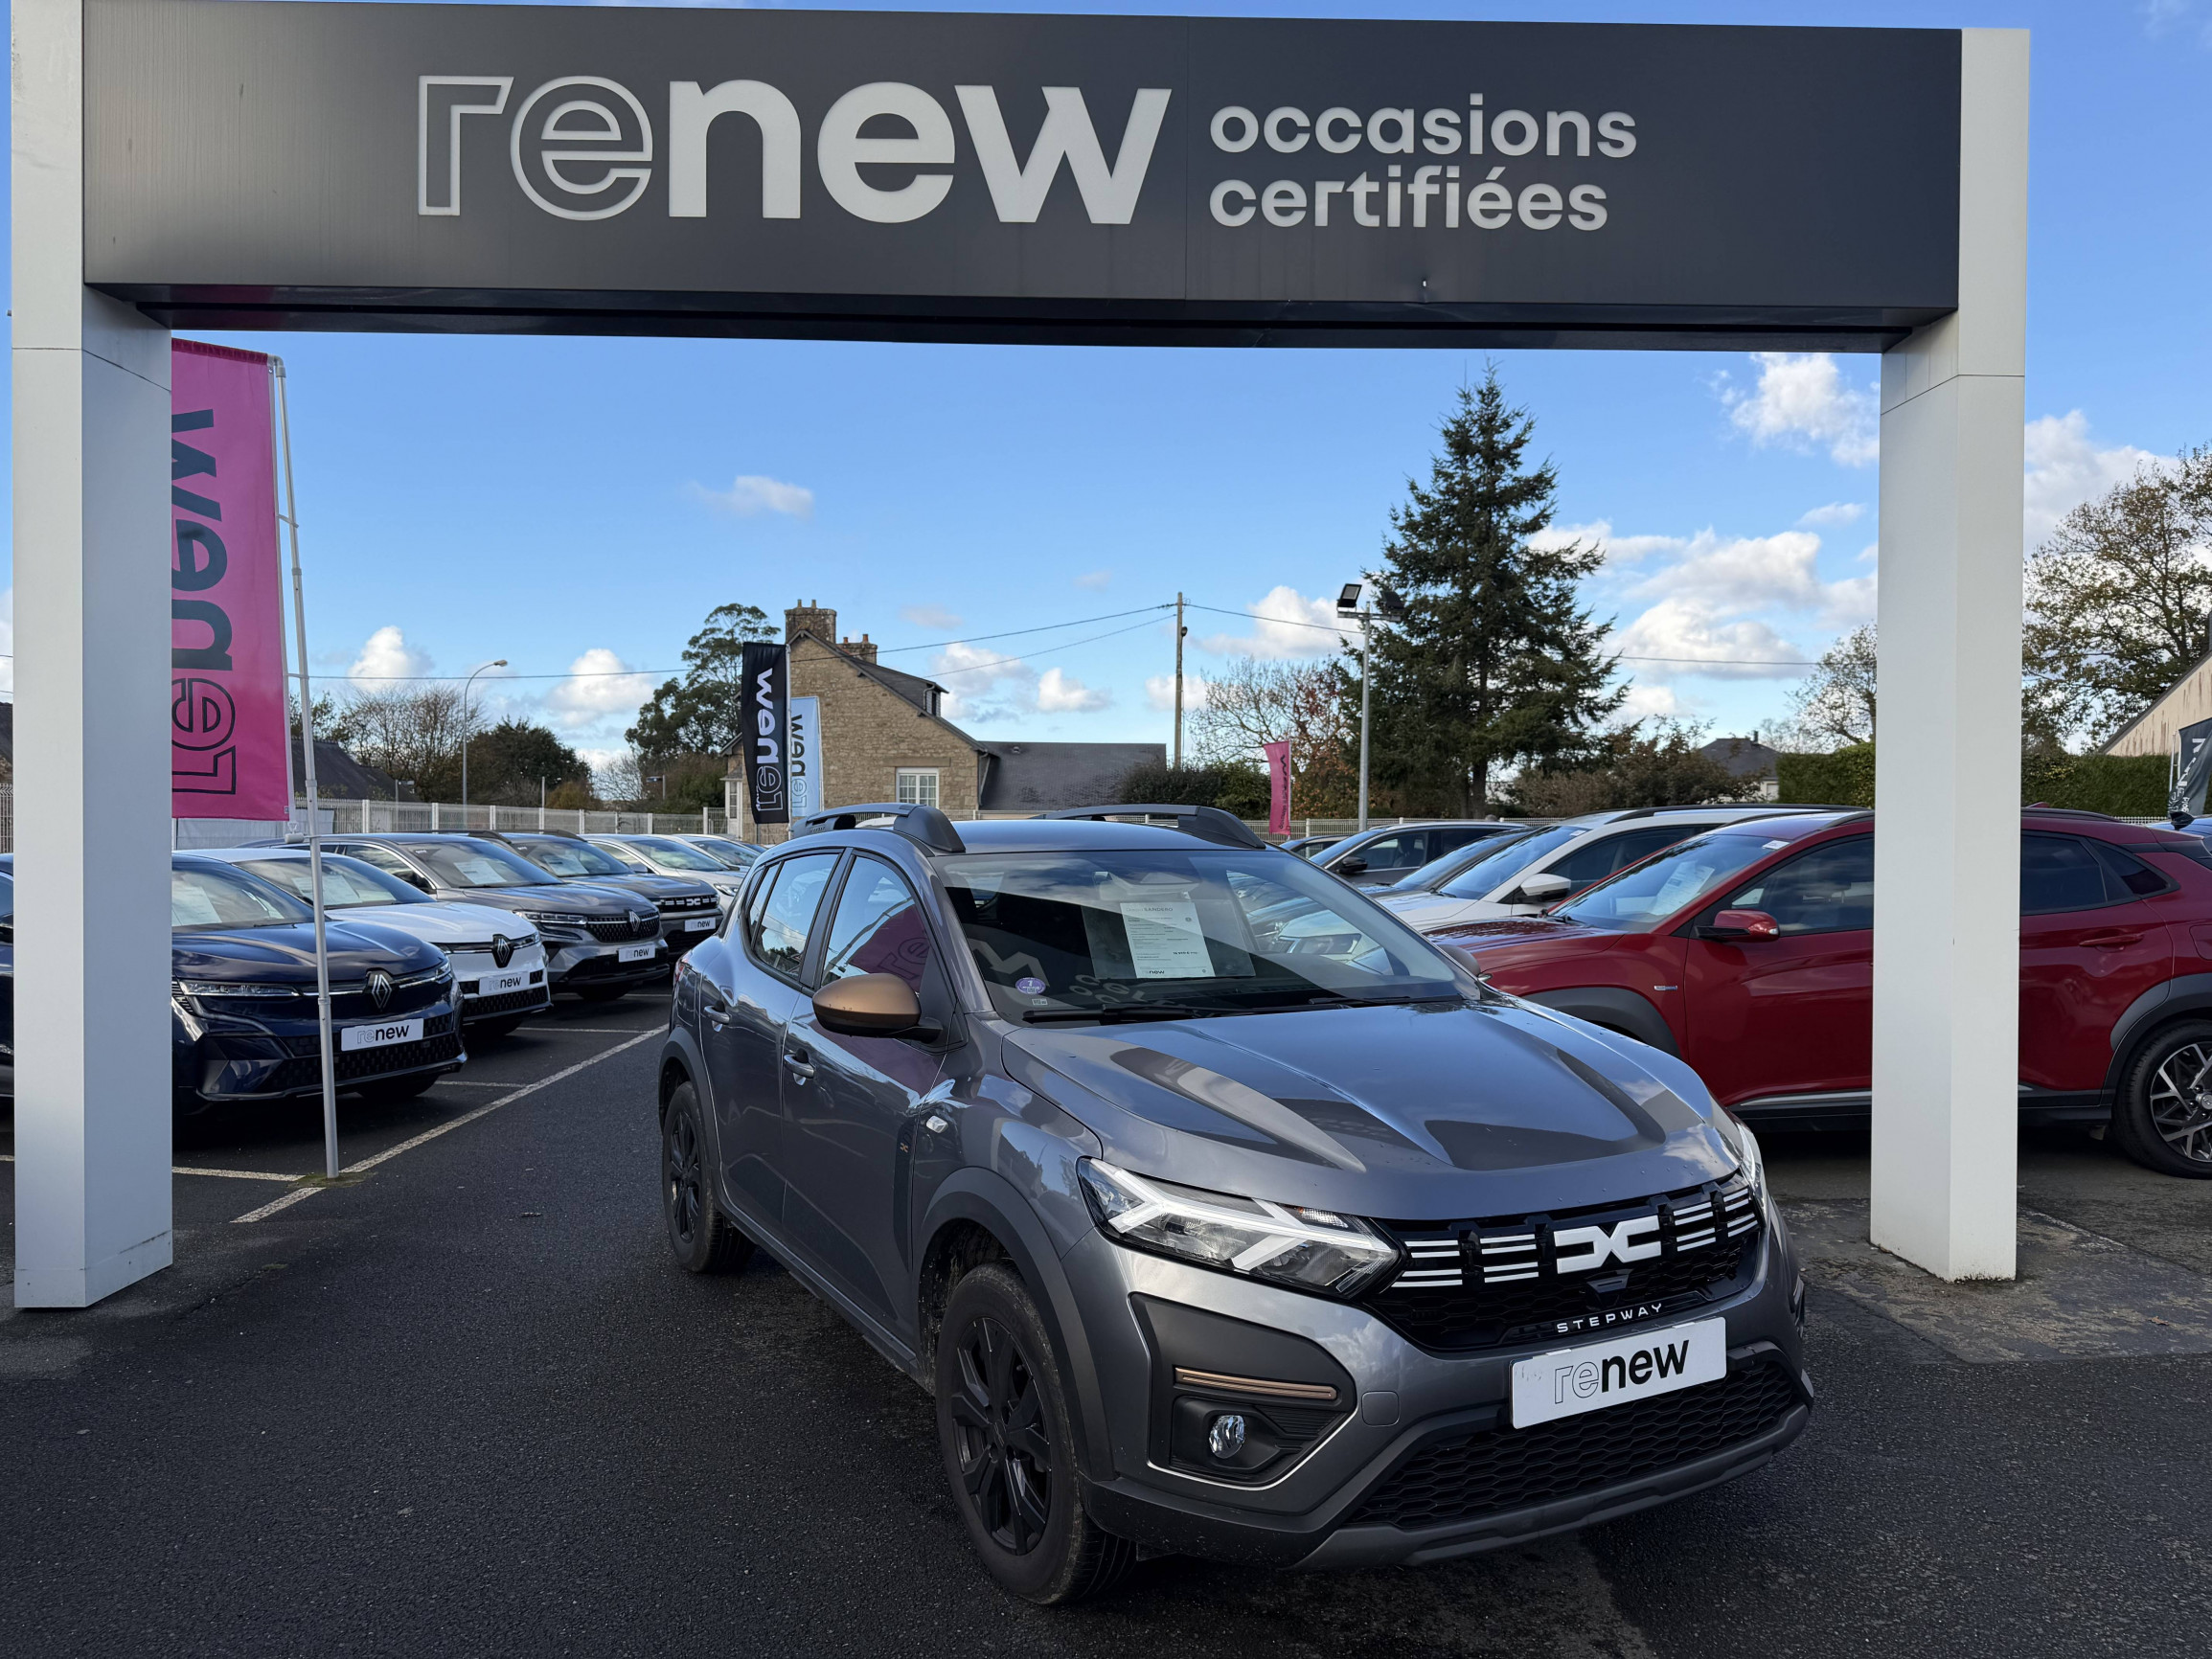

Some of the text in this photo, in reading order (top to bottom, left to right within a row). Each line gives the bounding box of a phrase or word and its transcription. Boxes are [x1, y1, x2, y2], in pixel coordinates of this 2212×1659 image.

[417, 74, 1172, 226] renew
[1209, 92, 1637, 158] occasions
[1208, 164, 1608, 231] certifiées
[488, 976, 522, 990] renew
[356, 1024, 410, 1045] renew
[1556, 1303, 1662, 1333] STEPWAY
[1554, 1339, 1690, 1405] renew
